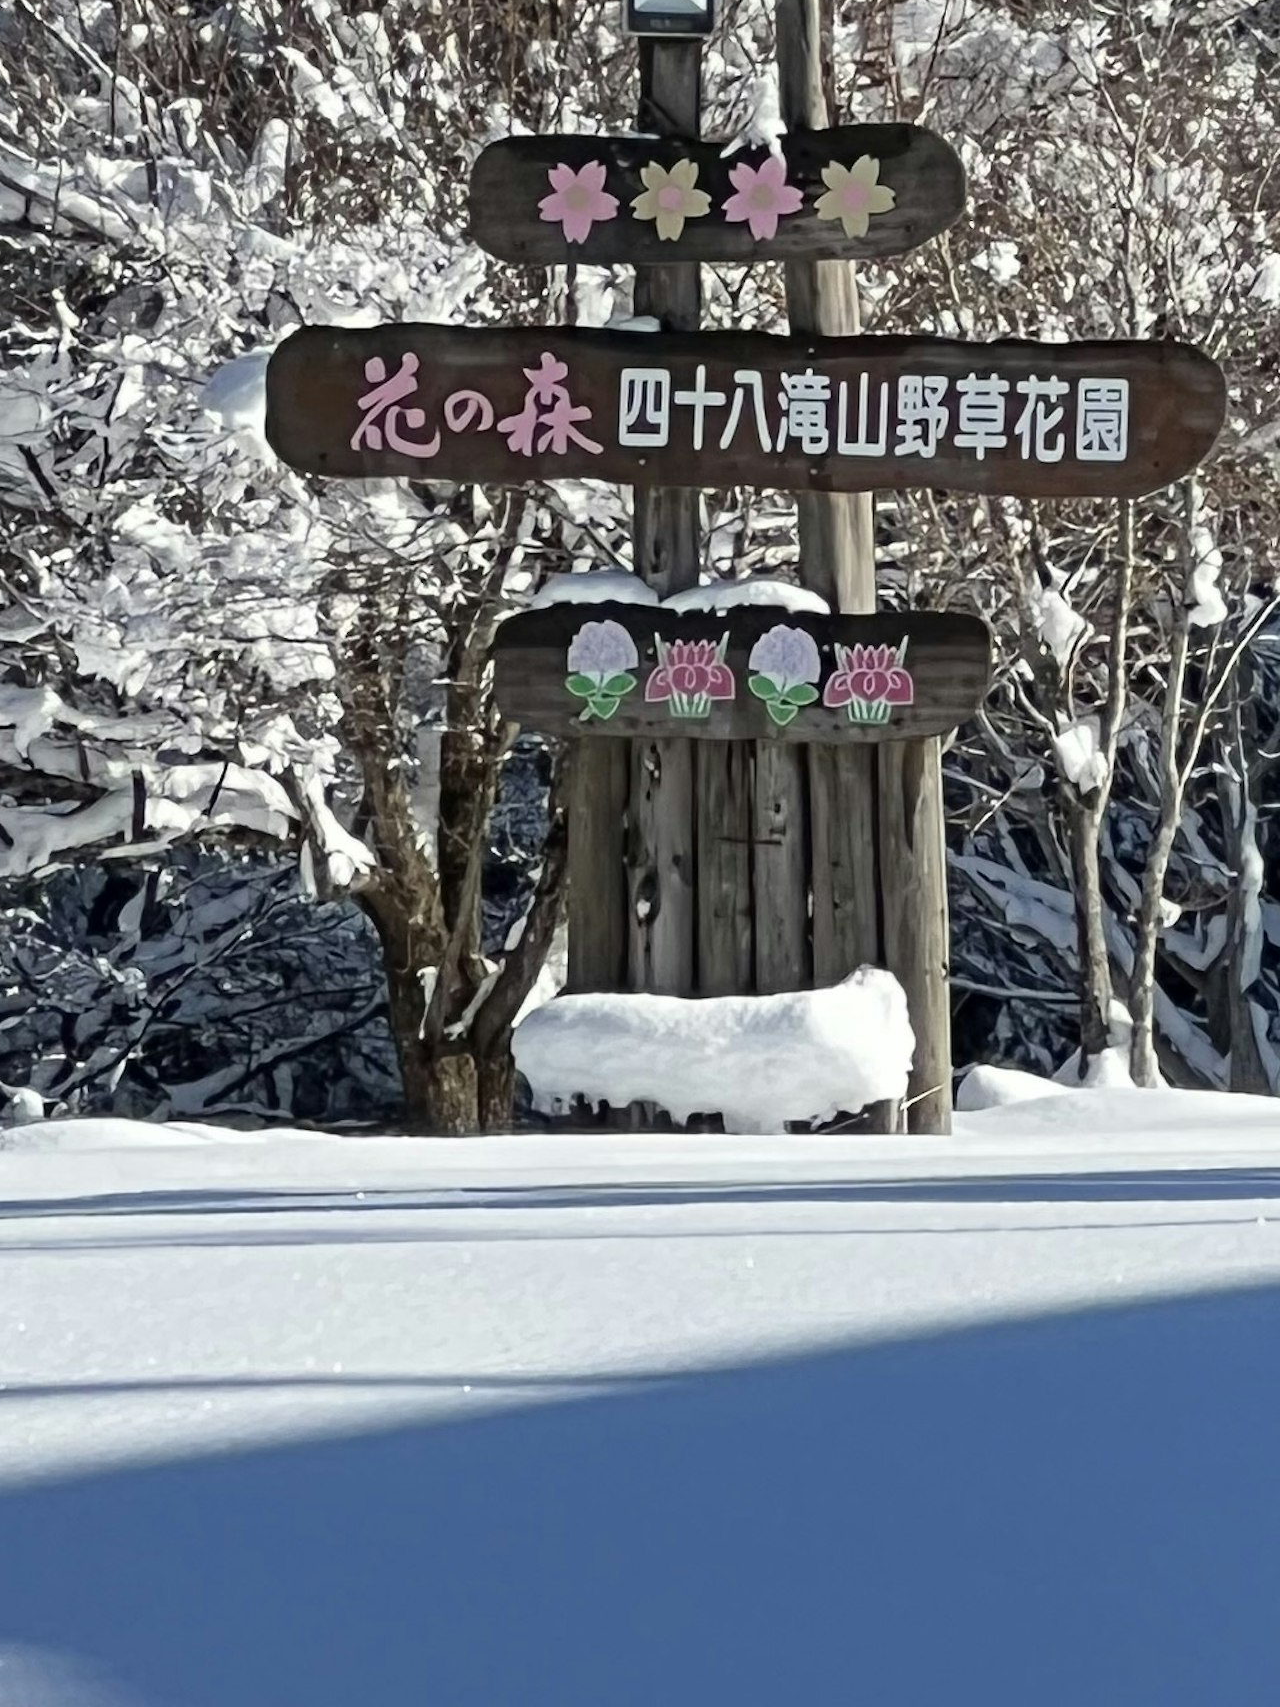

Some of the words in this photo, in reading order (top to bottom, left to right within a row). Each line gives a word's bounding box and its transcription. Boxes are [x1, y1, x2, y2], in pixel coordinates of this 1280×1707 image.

[350, 351, 604, 459] 花の森
[618, 364, 1130, 464] 四十八滝山野草花園
